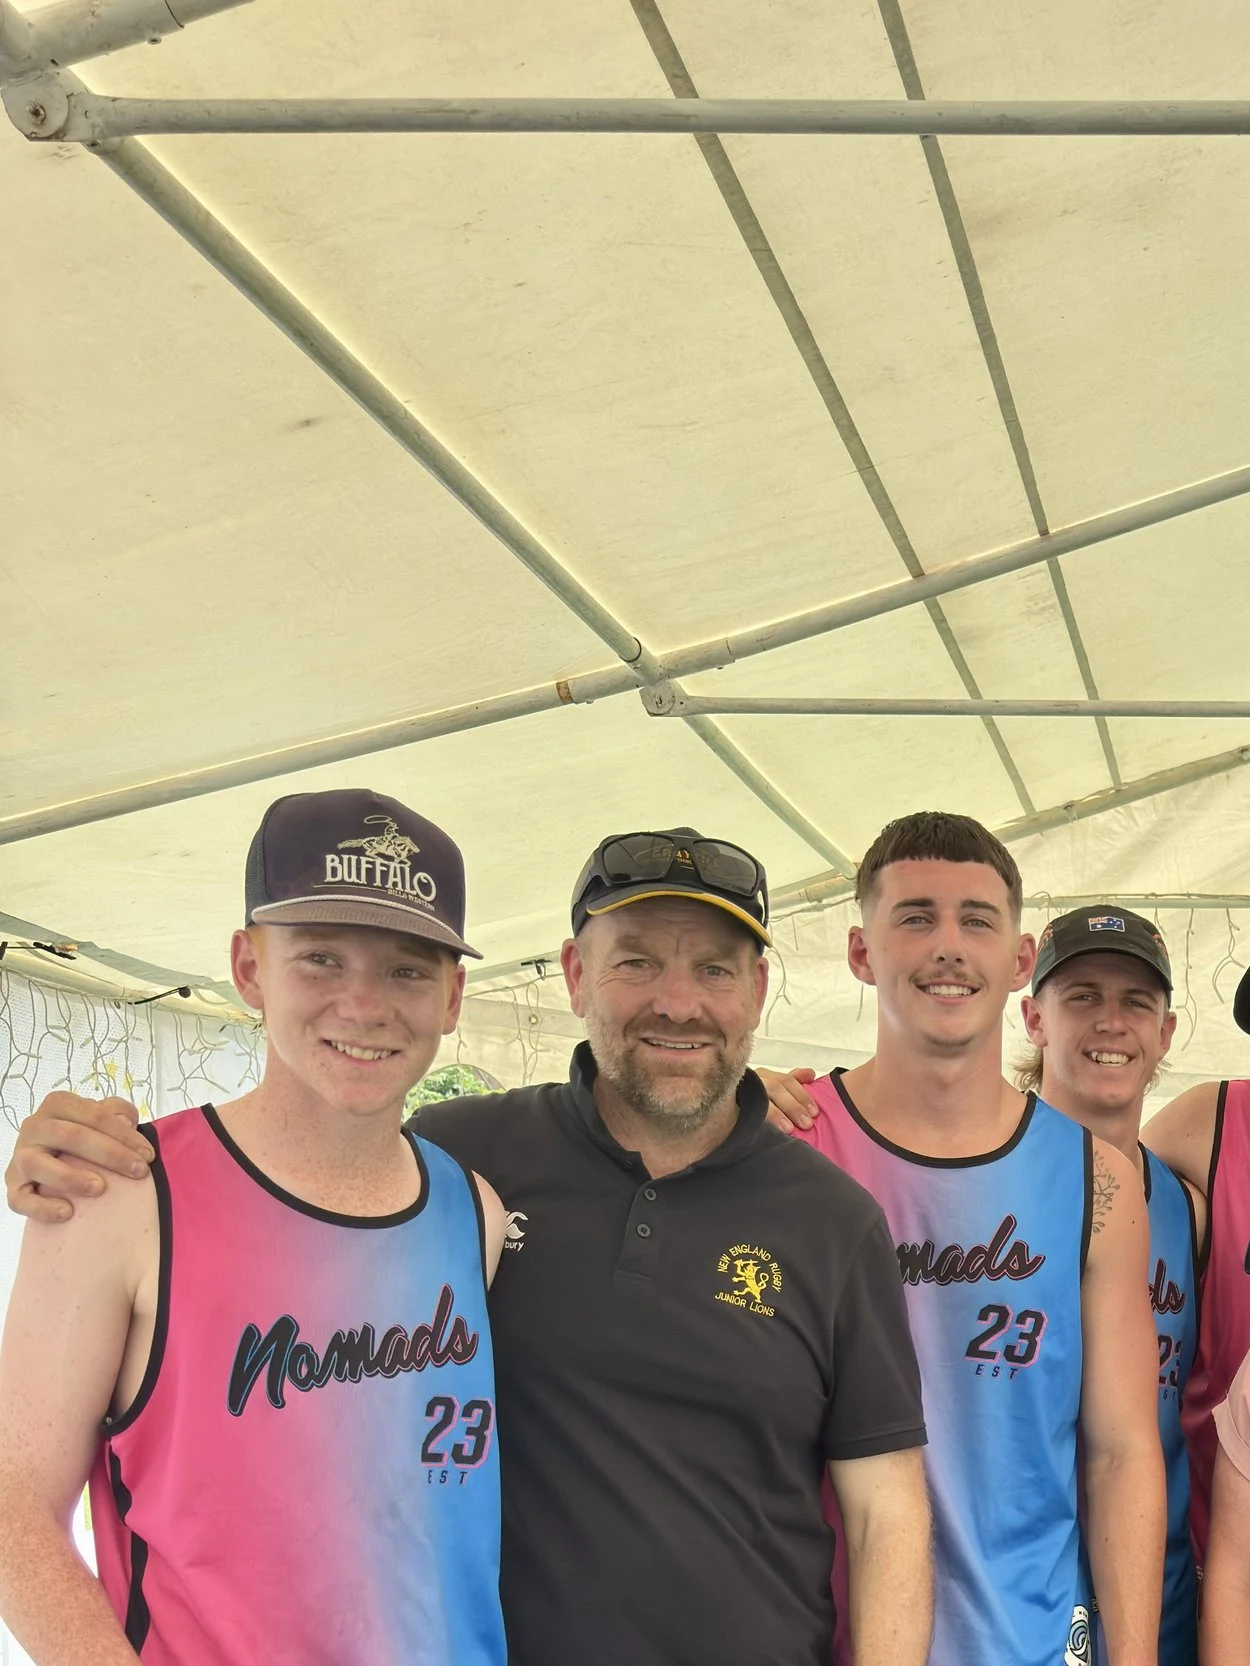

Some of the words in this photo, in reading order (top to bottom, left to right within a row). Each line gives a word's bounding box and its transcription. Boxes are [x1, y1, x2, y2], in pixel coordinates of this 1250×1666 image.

[324, 853, 437, 902] BUFFALO
[717, 1253, 732, 1273] NEW
[728, 1244, 771, 1261] ENGLAND
[768, 1262, 783, 1293] RUGBY
[897, 1213, 1046, 1287] mads
[714, 1291, 747, 1308] JUNIOR
[749, 1301, 775, 1317] LIONS
[227, 1283, 479, 1417] Nomads
[964, 1302, 1048, 1368] 23
[975, 1363, 1019, 1380] EST
[420, 1394, 496, 1468] 23
[427, 1469, 469, 1485] EST
